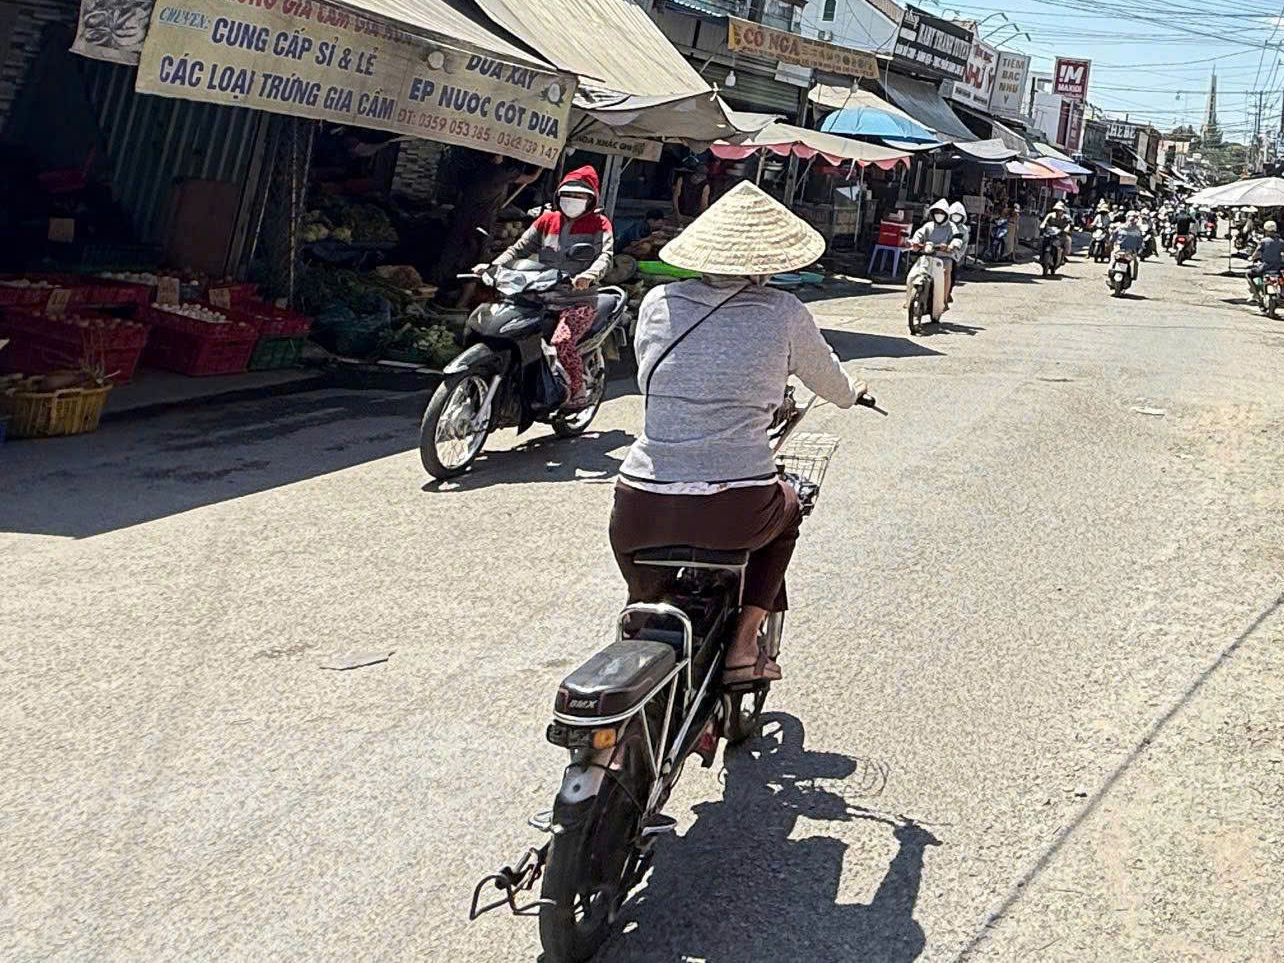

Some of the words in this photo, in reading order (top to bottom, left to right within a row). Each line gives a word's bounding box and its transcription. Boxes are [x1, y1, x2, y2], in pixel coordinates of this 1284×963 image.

[211, 18, 270, 52] CUNG
[273, 27, 313, 61] CẤP
[315, 37, 339, 67] SỈ
[338, 48, 352, 71] &
[355, 47, 379, 76] LẺ
[159, 53, 204, 87] CÁC
[207, 64, 256, 99] LOẠI
[258, 73, 321, 107] TRỨNG
[323, 86, 354, 112] GIA
[357, 87, 396, 120] CẦM
[418, 113, 447, 132] 0359
[449, 120, 470, 137] 053
